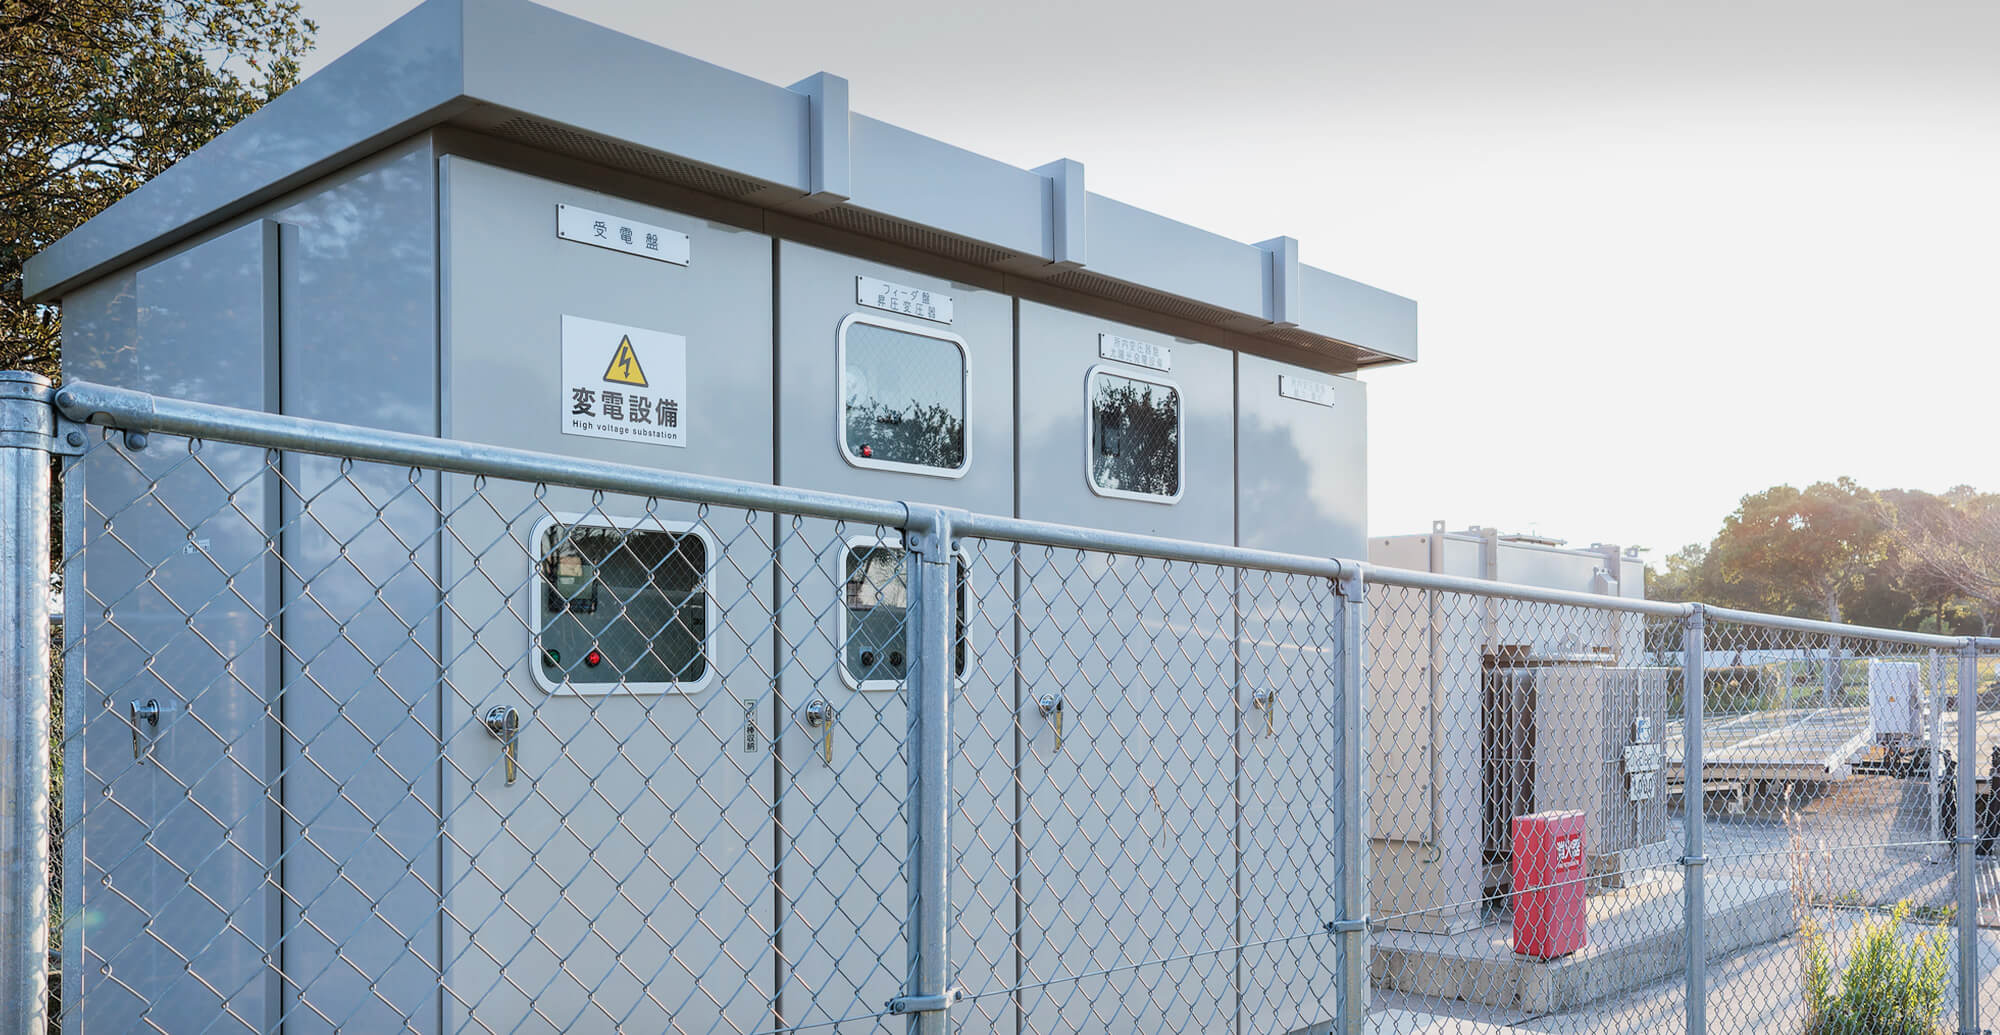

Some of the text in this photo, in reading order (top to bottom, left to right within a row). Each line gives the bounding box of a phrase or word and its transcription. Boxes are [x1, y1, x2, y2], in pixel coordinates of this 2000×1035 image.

[593, 220, 659, 251] 受電盤
[571, 387, 679, 428] 変電設備
[572, 419, 678, 440] High voltage substation
